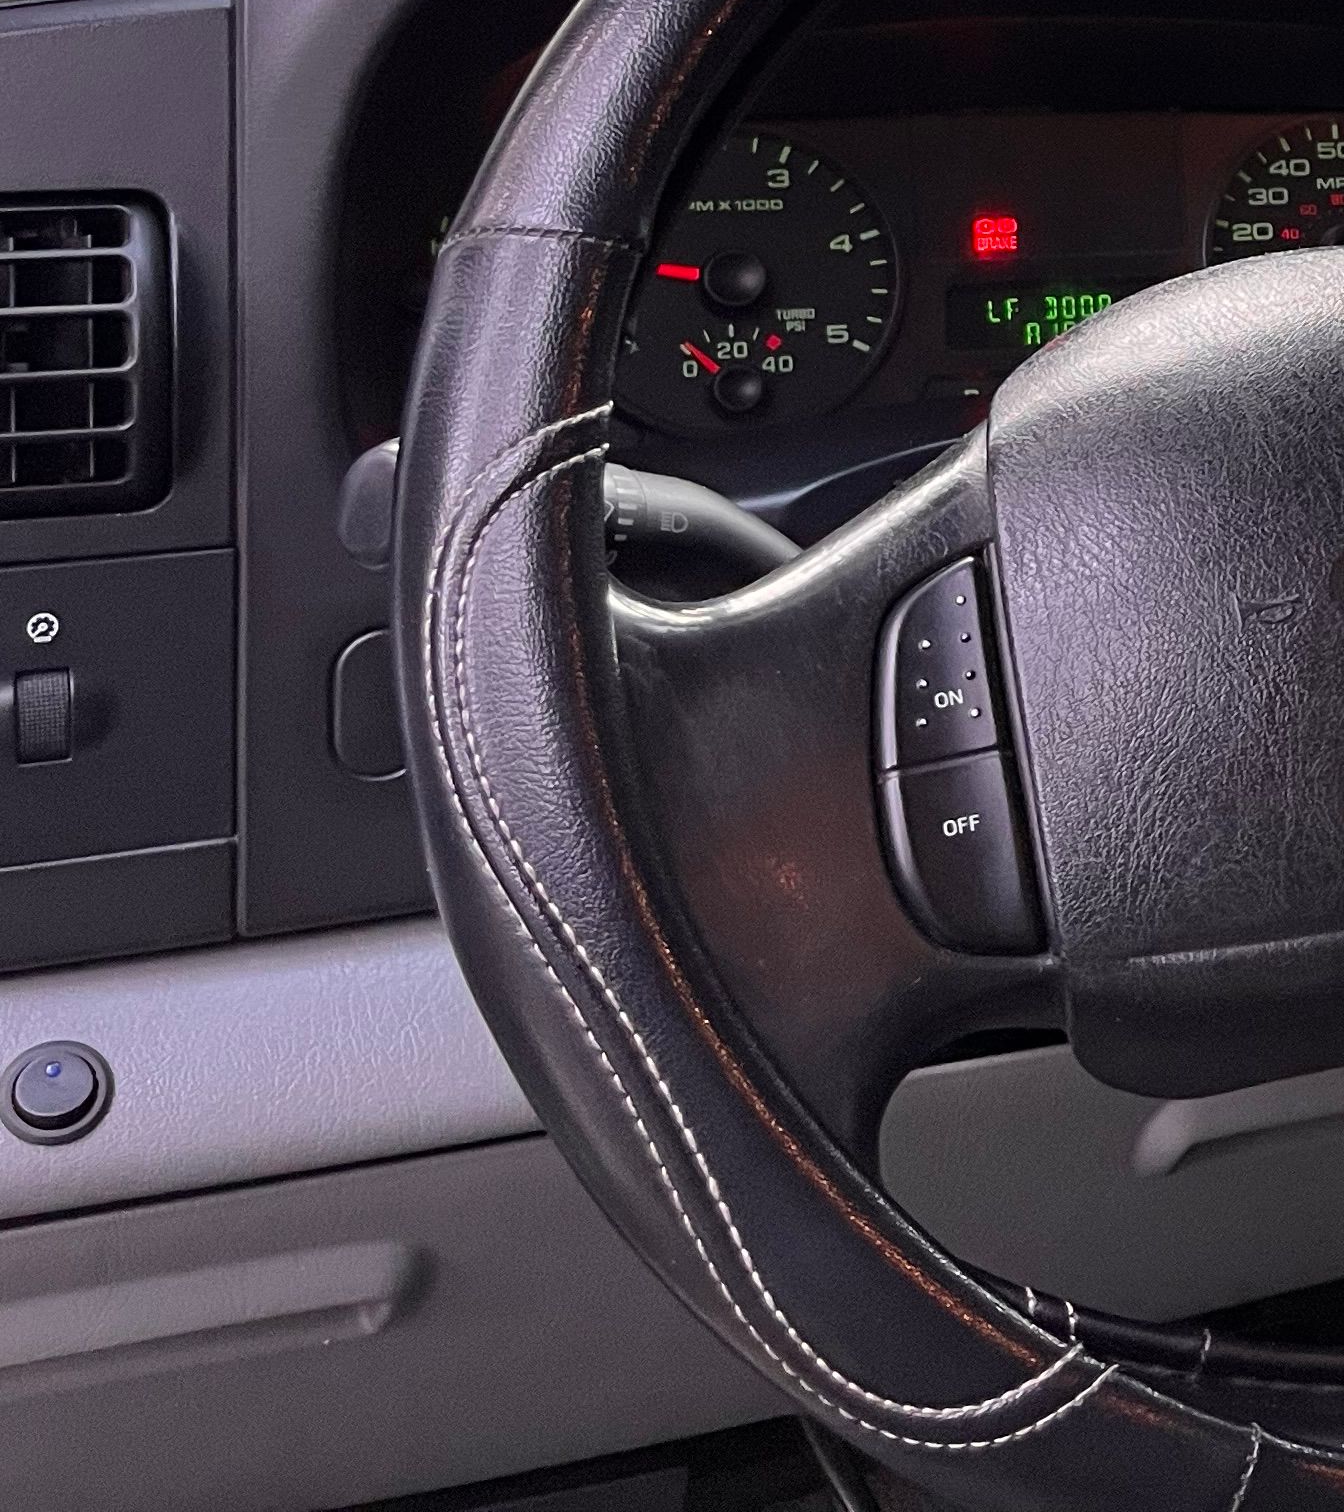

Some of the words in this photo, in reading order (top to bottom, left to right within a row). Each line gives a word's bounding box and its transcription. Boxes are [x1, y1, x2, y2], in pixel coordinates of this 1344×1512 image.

[1268, 159, 1311, 177] 40
[767, 169, 790, 188] 3
[1247, 188, 1289, 206] 30
[1232, 223, 1273, 241] 20
[829, 234, 853, 253] 4
[776, 308, 815, 321] TURBO
[988, 298, 1019, 323] LF
[786, 320, 806, 332] PSI
[826, 325, 849, 343] 5
[717, 341, 748, 359] 20
[683, 360, 698, 378] 0
[761, 356, 793, 373] 40
[934, 689, 964, 709] ON
[942, 814, 980, 837] OFF
